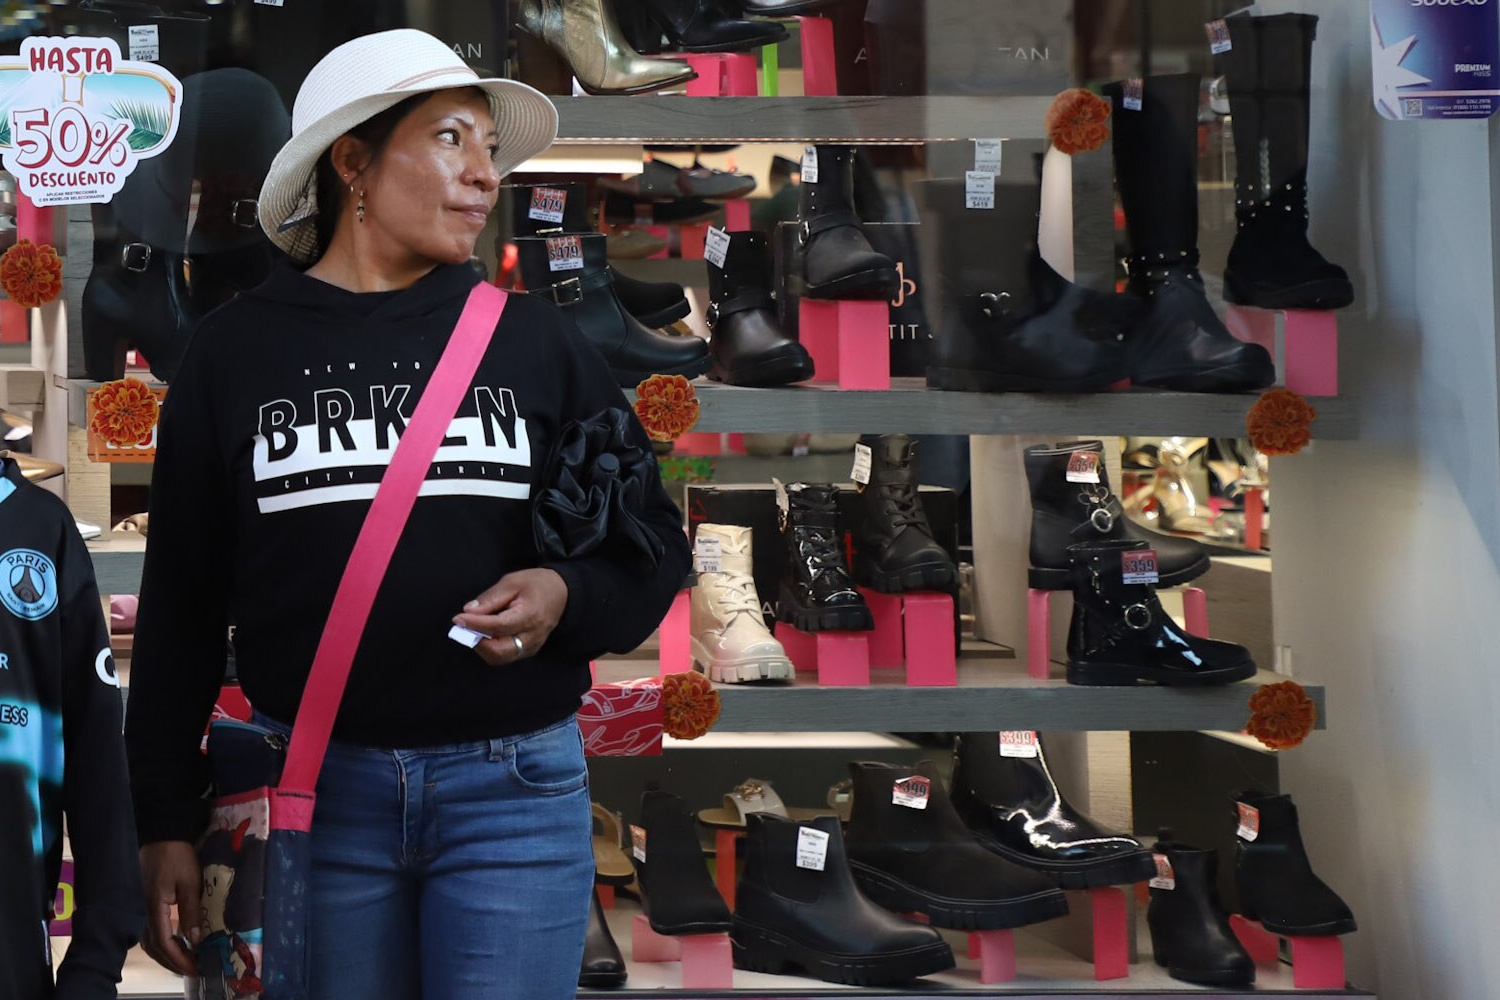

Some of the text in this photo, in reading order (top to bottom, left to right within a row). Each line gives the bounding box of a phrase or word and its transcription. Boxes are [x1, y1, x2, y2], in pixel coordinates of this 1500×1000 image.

[29, 46, 113, 73] HASTA
[1454, 63, 1492, 73] PREMIUM
[12, 106, 130, 169] 50%
[29, 171, 116, 188] DESCUENTO
[532, 196, 563, 211] $479
[549, 246, 580, 262] $479
[304, 362, 357, 376] NEW
[257, 384, 519, 463] BRKN
[284, 470, 355, 490] CITY
[6, 554, 49, 573] PARIS
[1123, 558, 1155, 573] $359
